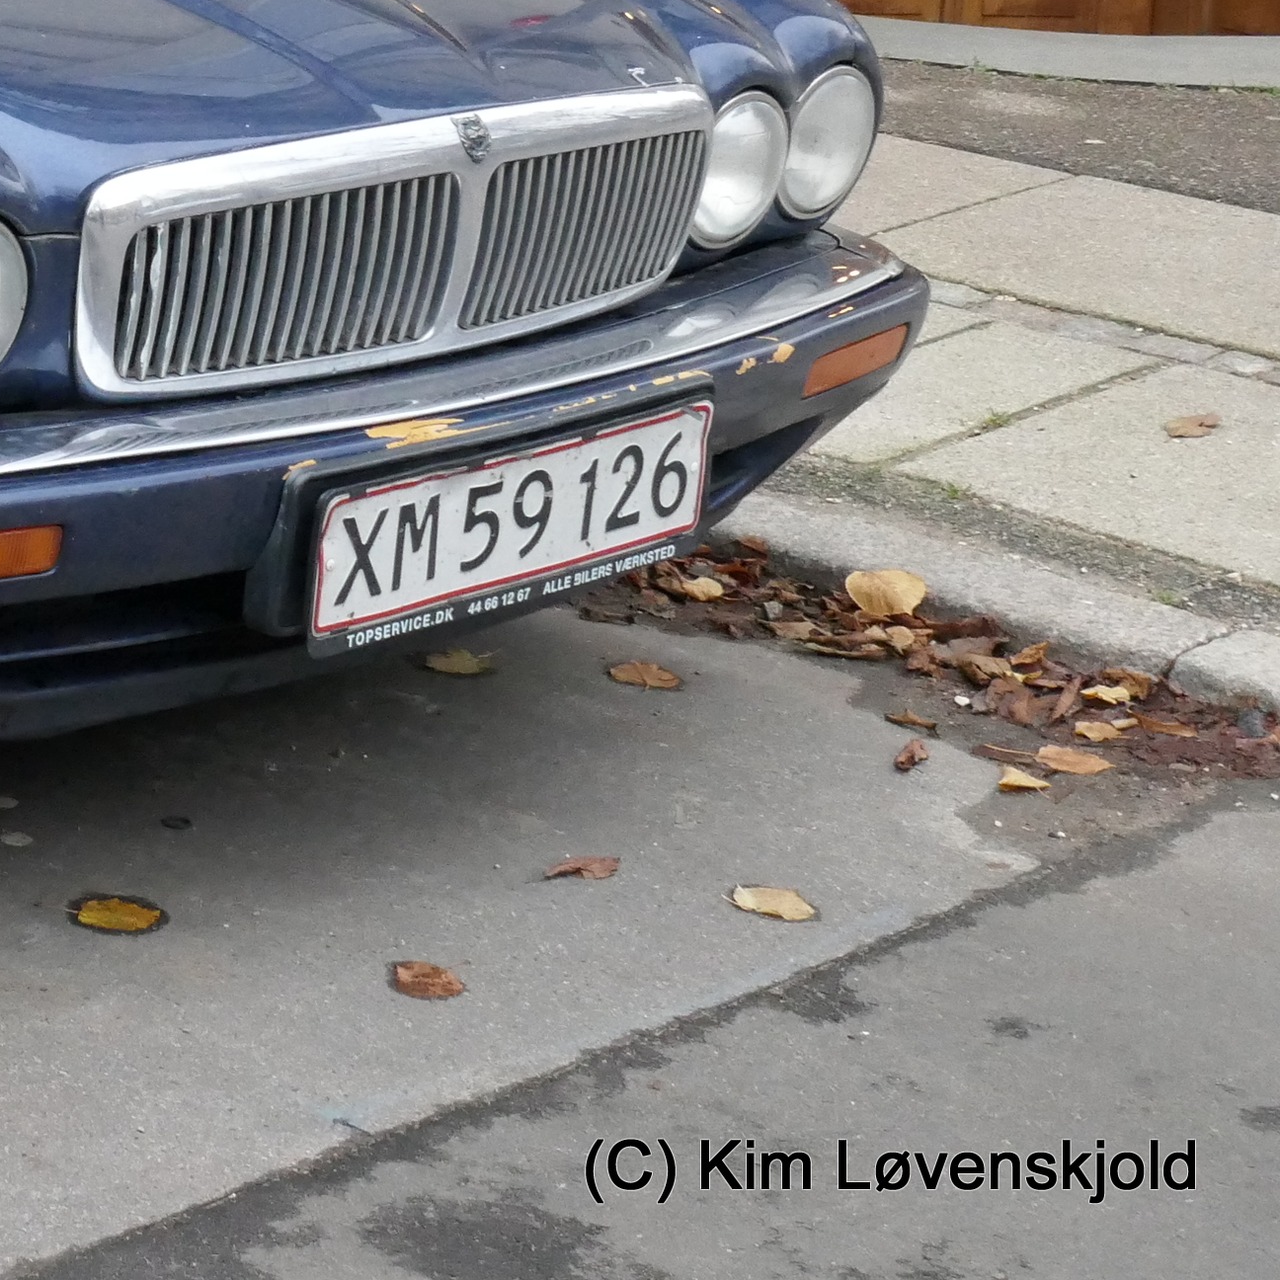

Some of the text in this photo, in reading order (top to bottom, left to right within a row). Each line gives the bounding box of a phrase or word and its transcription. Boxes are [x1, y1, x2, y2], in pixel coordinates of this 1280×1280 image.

[334, 431, 687, 606] XM 59 126
[346, 545, 675, 648] TOPSERVICE.DK 44 66 12 67 ALLE BILERS VÆRKSTED
